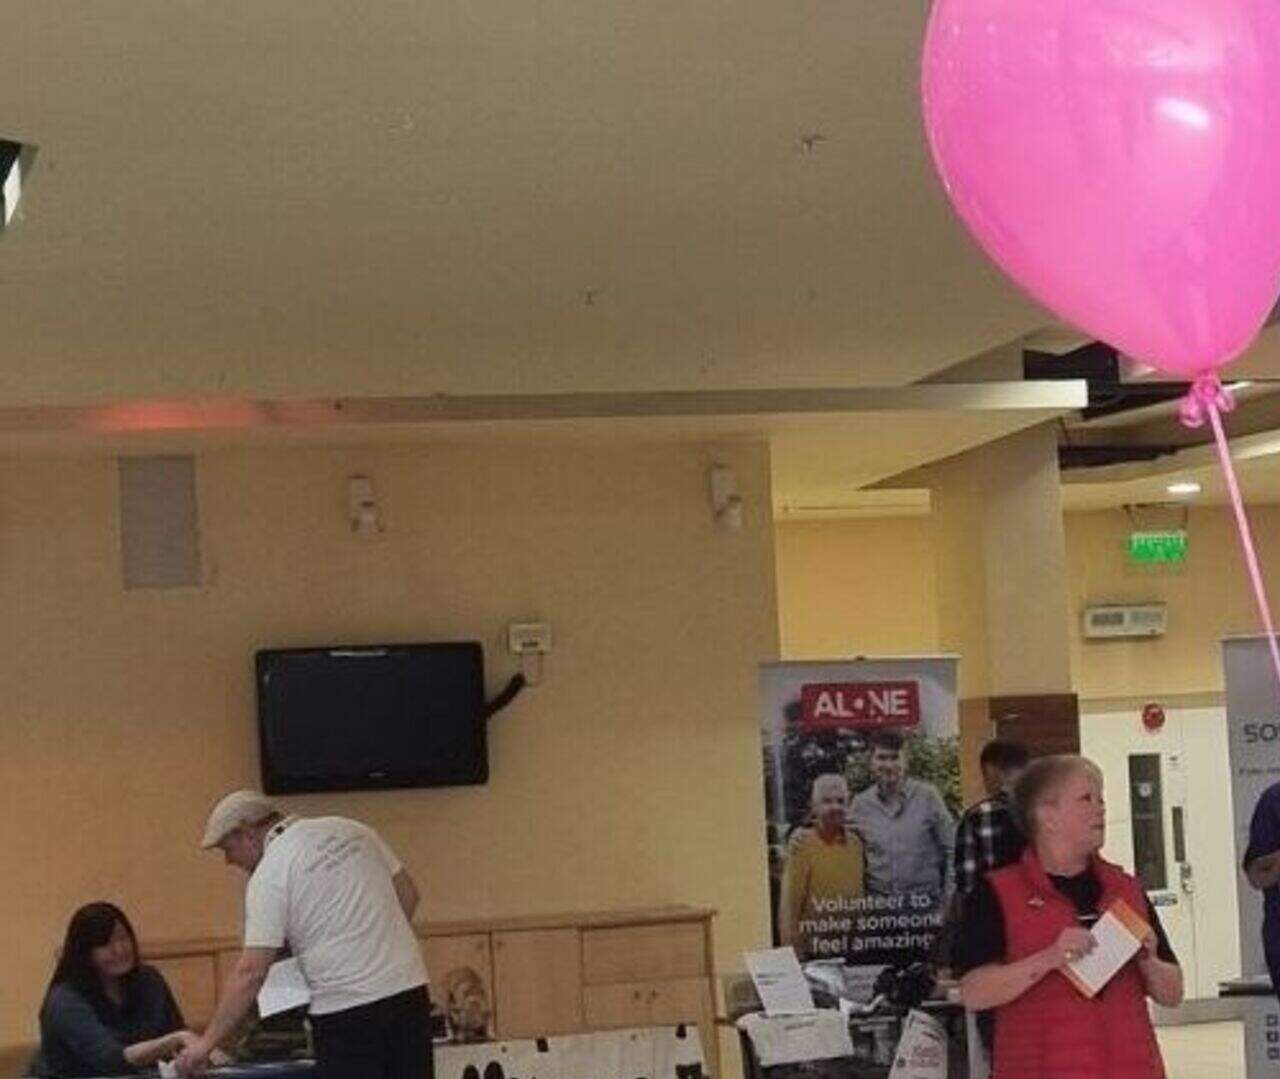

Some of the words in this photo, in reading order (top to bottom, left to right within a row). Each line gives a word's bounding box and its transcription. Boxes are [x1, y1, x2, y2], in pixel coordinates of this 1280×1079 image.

[813, 895, 905, 912] Volunteer
[910, 894, 931, 908] to
[799, 915, 851, 932] make
[813, 937, 848, 953] feel
